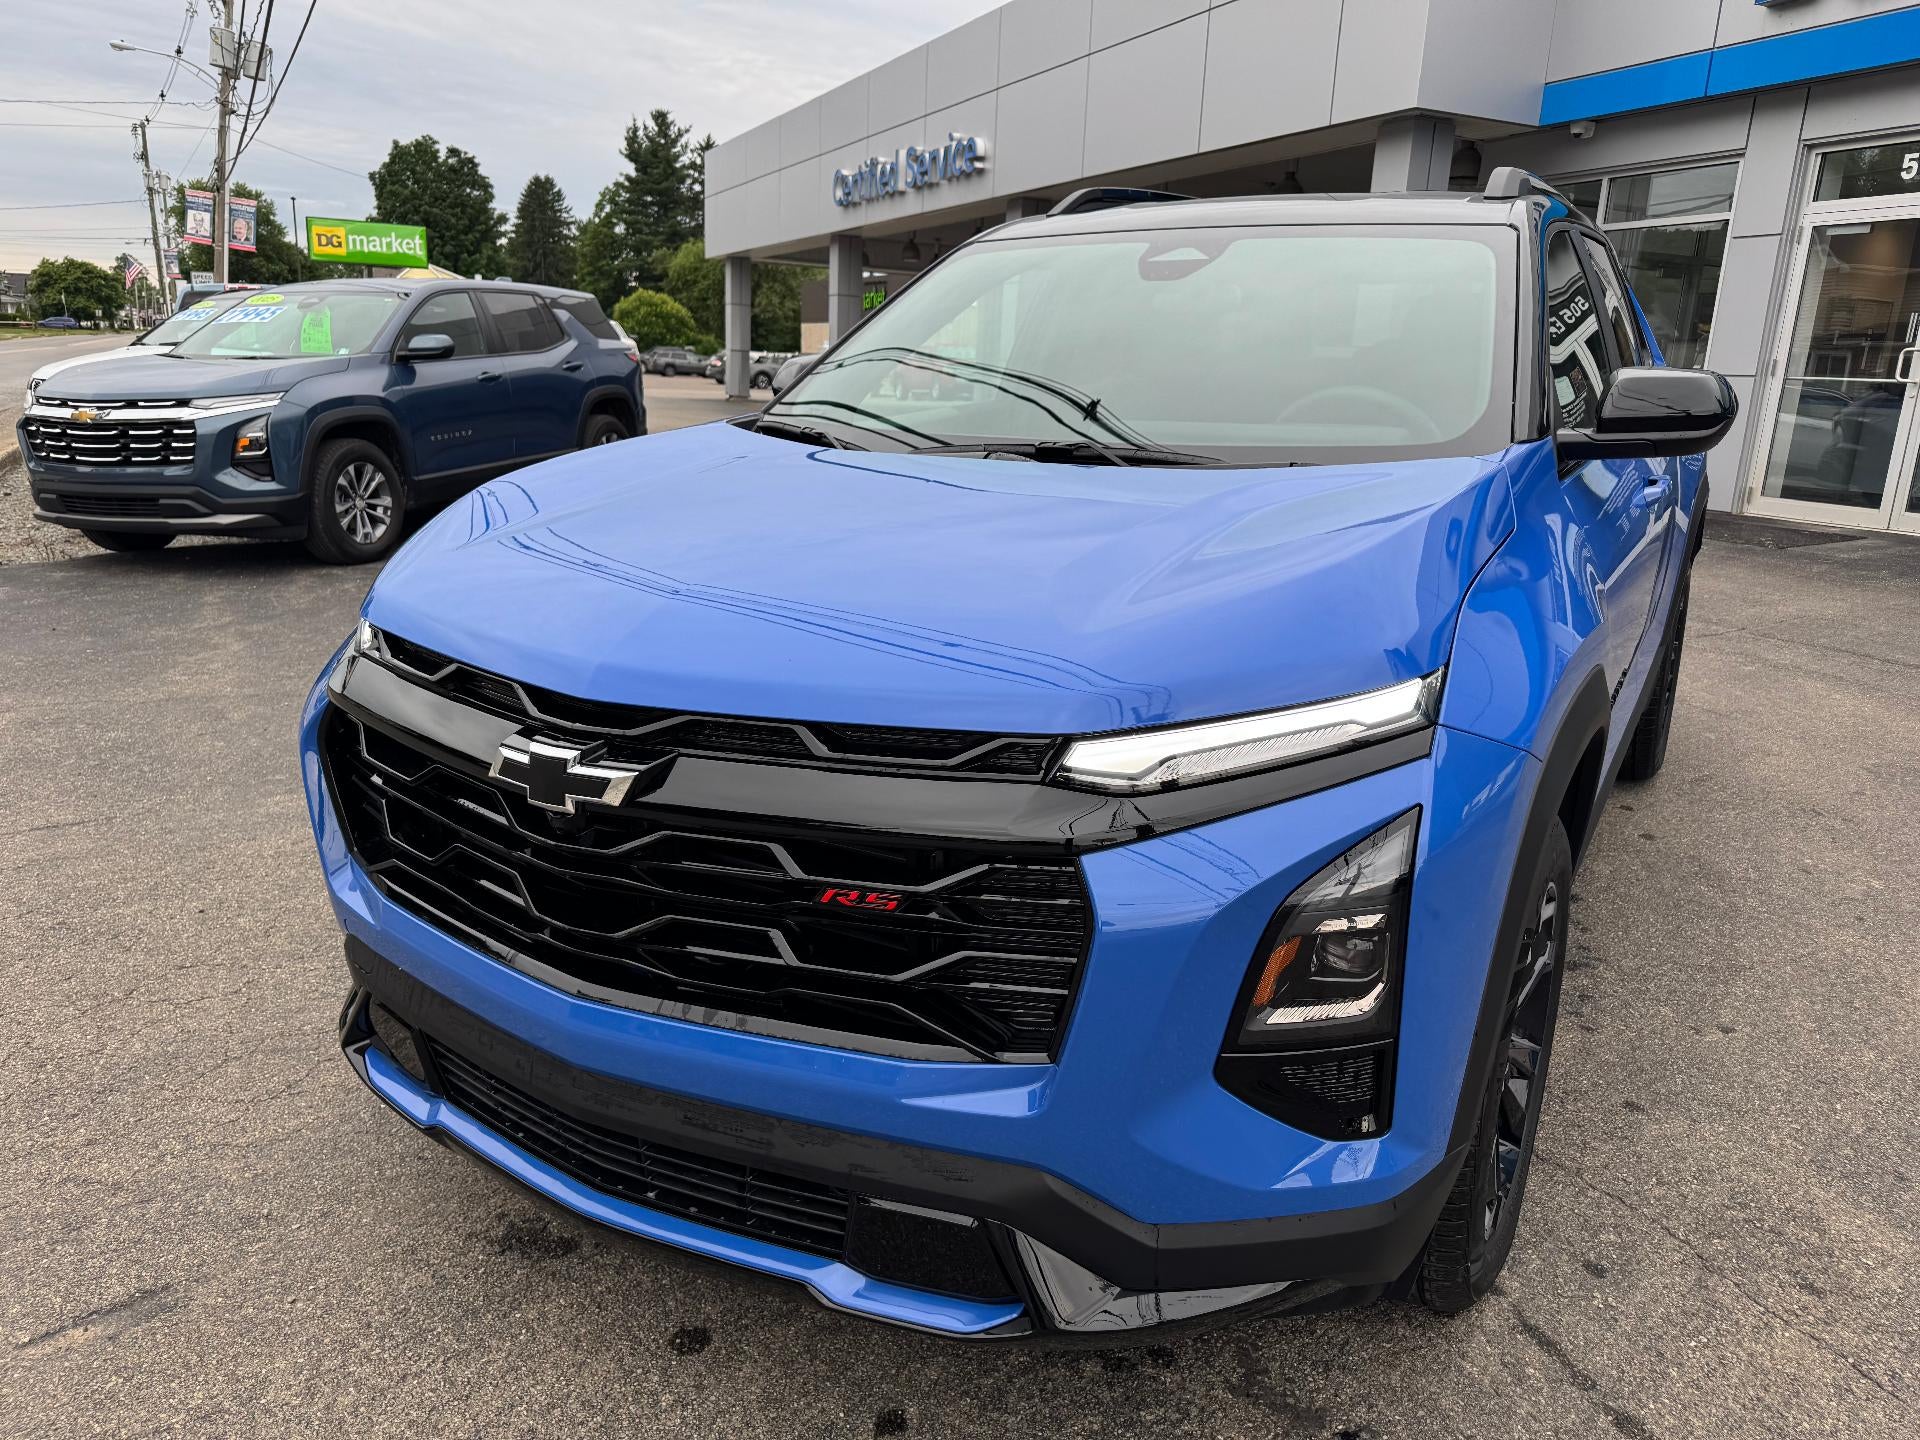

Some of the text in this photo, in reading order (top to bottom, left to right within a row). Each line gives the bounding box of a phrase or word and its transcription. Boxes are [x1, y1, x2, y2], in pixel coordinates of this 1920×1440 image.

[833, 132, 980, 206] Certified Service
[316, 232, 423, 255] DG market
[863, 287, 886, 309] arket
[820, 887, 903, 911] RS
